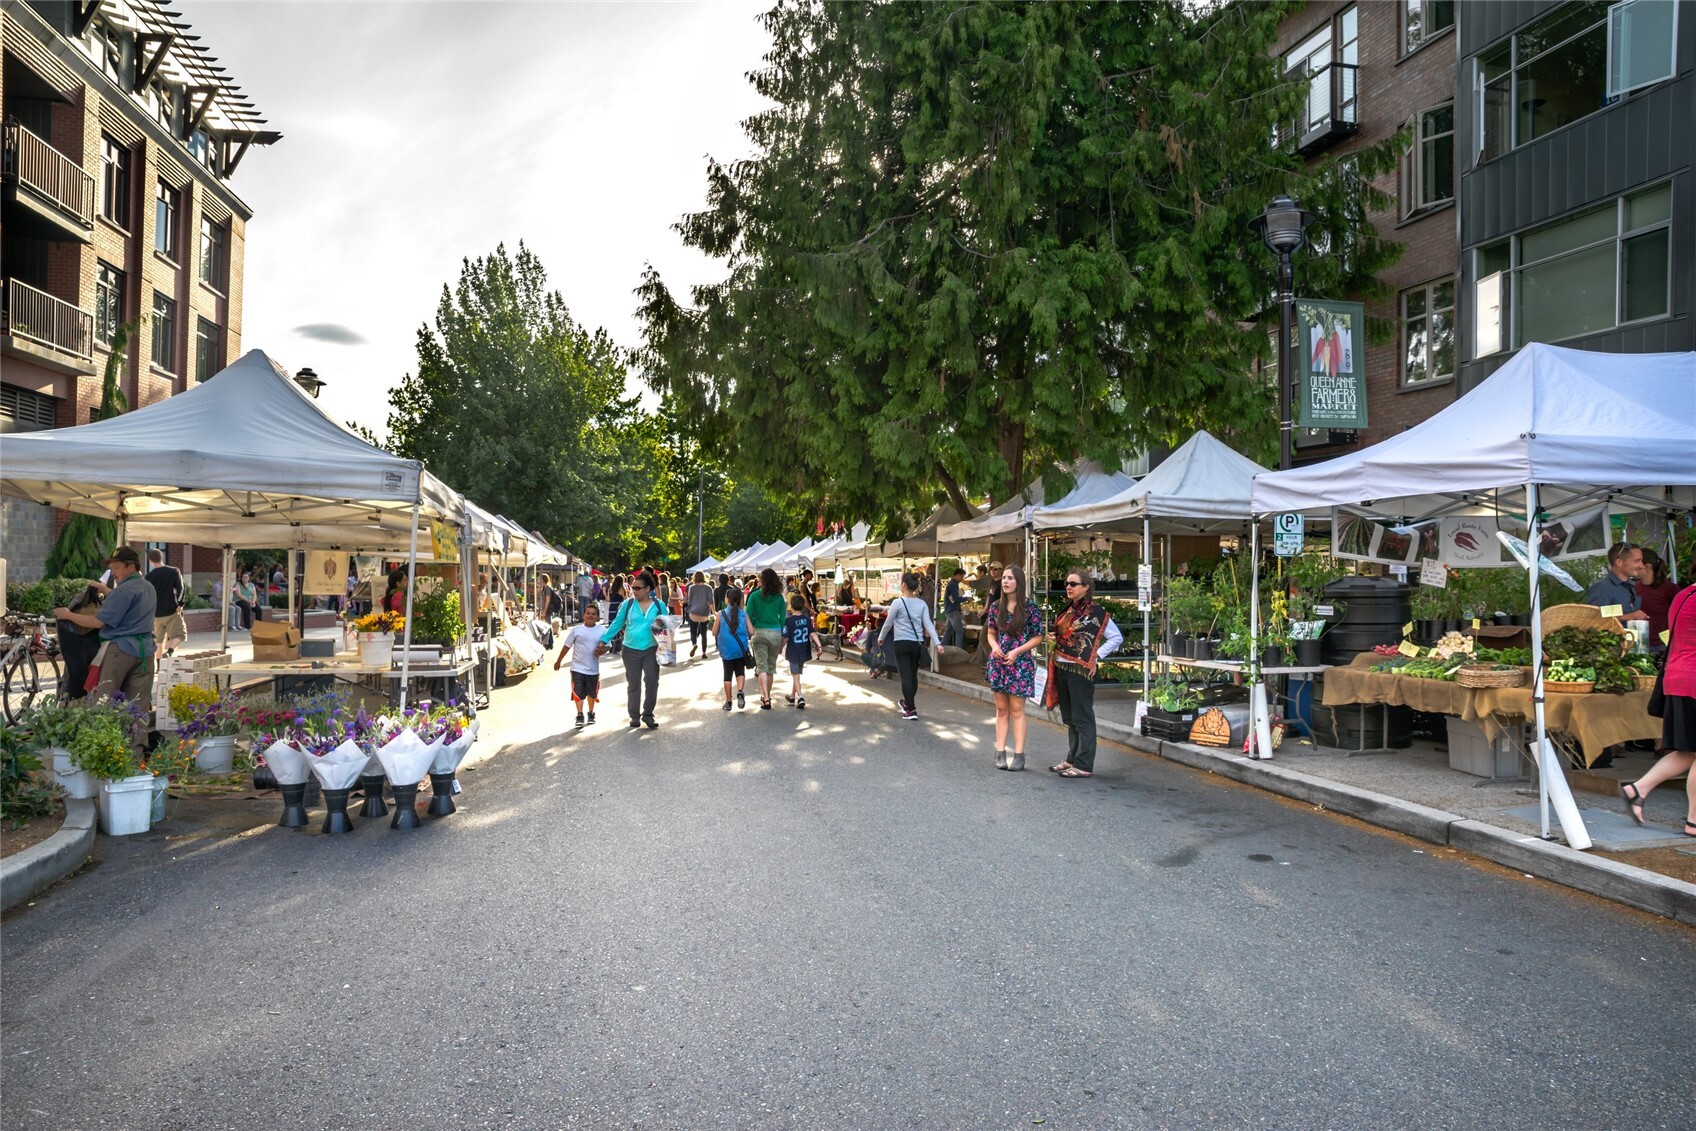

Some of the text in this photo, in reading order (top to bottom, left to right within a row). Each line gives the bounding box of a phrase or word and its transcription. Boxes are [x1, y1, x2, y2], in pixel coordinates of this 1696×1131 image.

[1310, 376, 1357, 389] QUEEN ANNE
[1311, 387, 1357, 404] FARMERS
[1285, 515, 1295, 528] P
[1447, 523, 1461, 538] Local
[1461, 522, 1477, 530] Roots
[793, 627, 809, 643] 22
